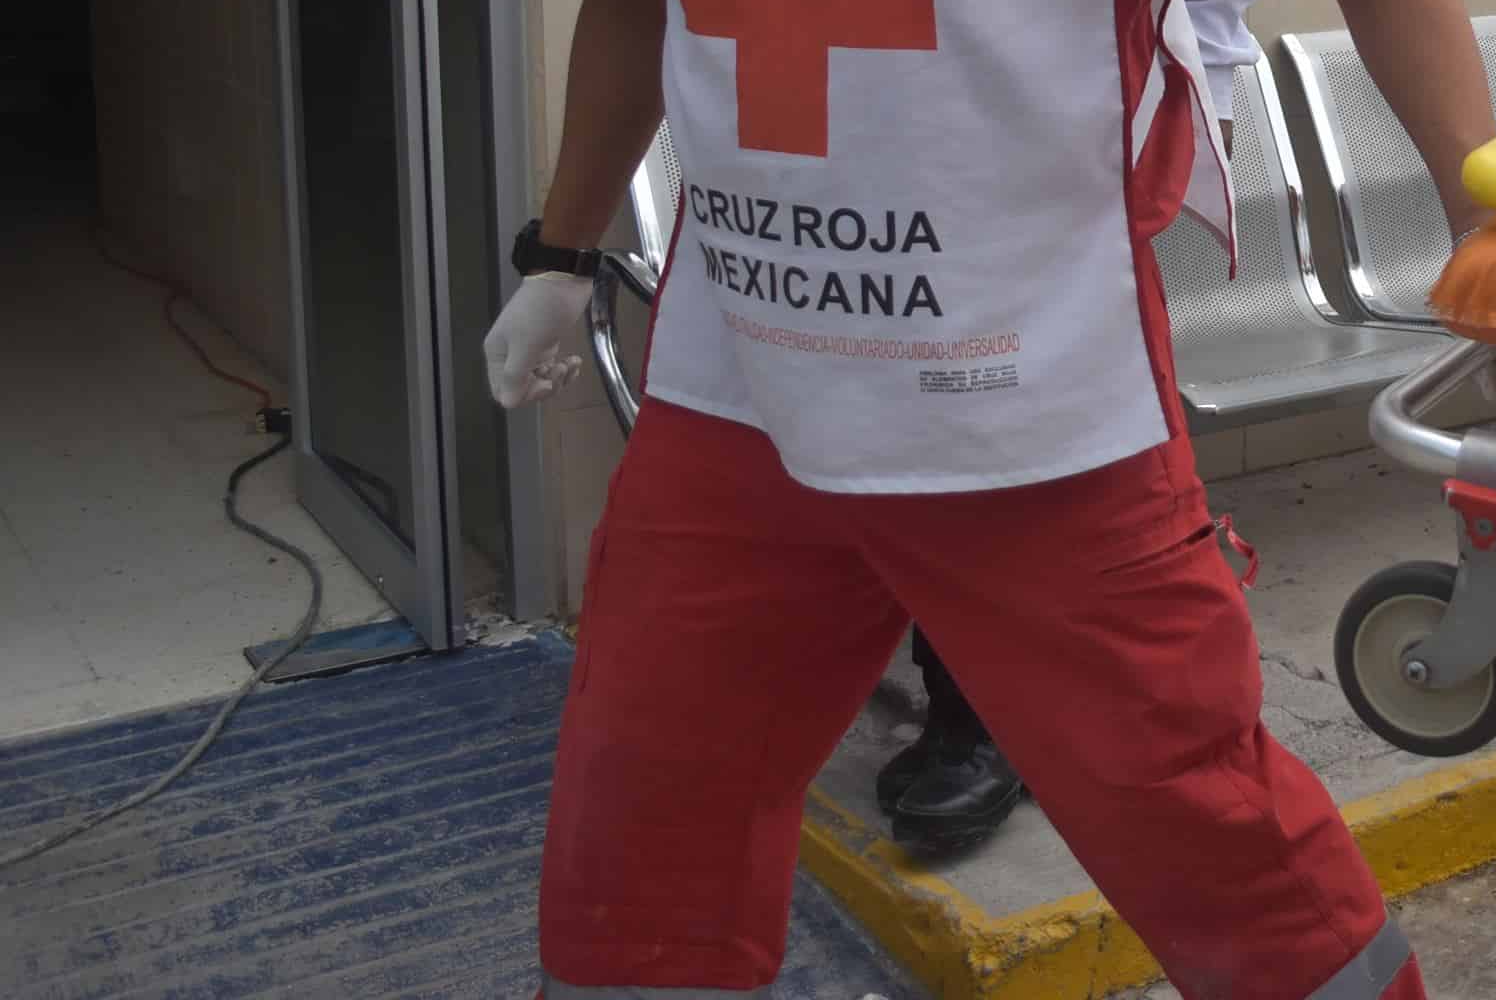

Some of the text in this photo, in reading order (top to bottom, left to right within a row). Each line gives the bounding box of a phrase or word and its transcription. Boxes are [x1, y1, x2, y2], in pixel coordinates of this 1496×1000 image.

[690, 184, 943, 254] CRUZ ROJA
[697, 238, 944, 317] MEXICANA
